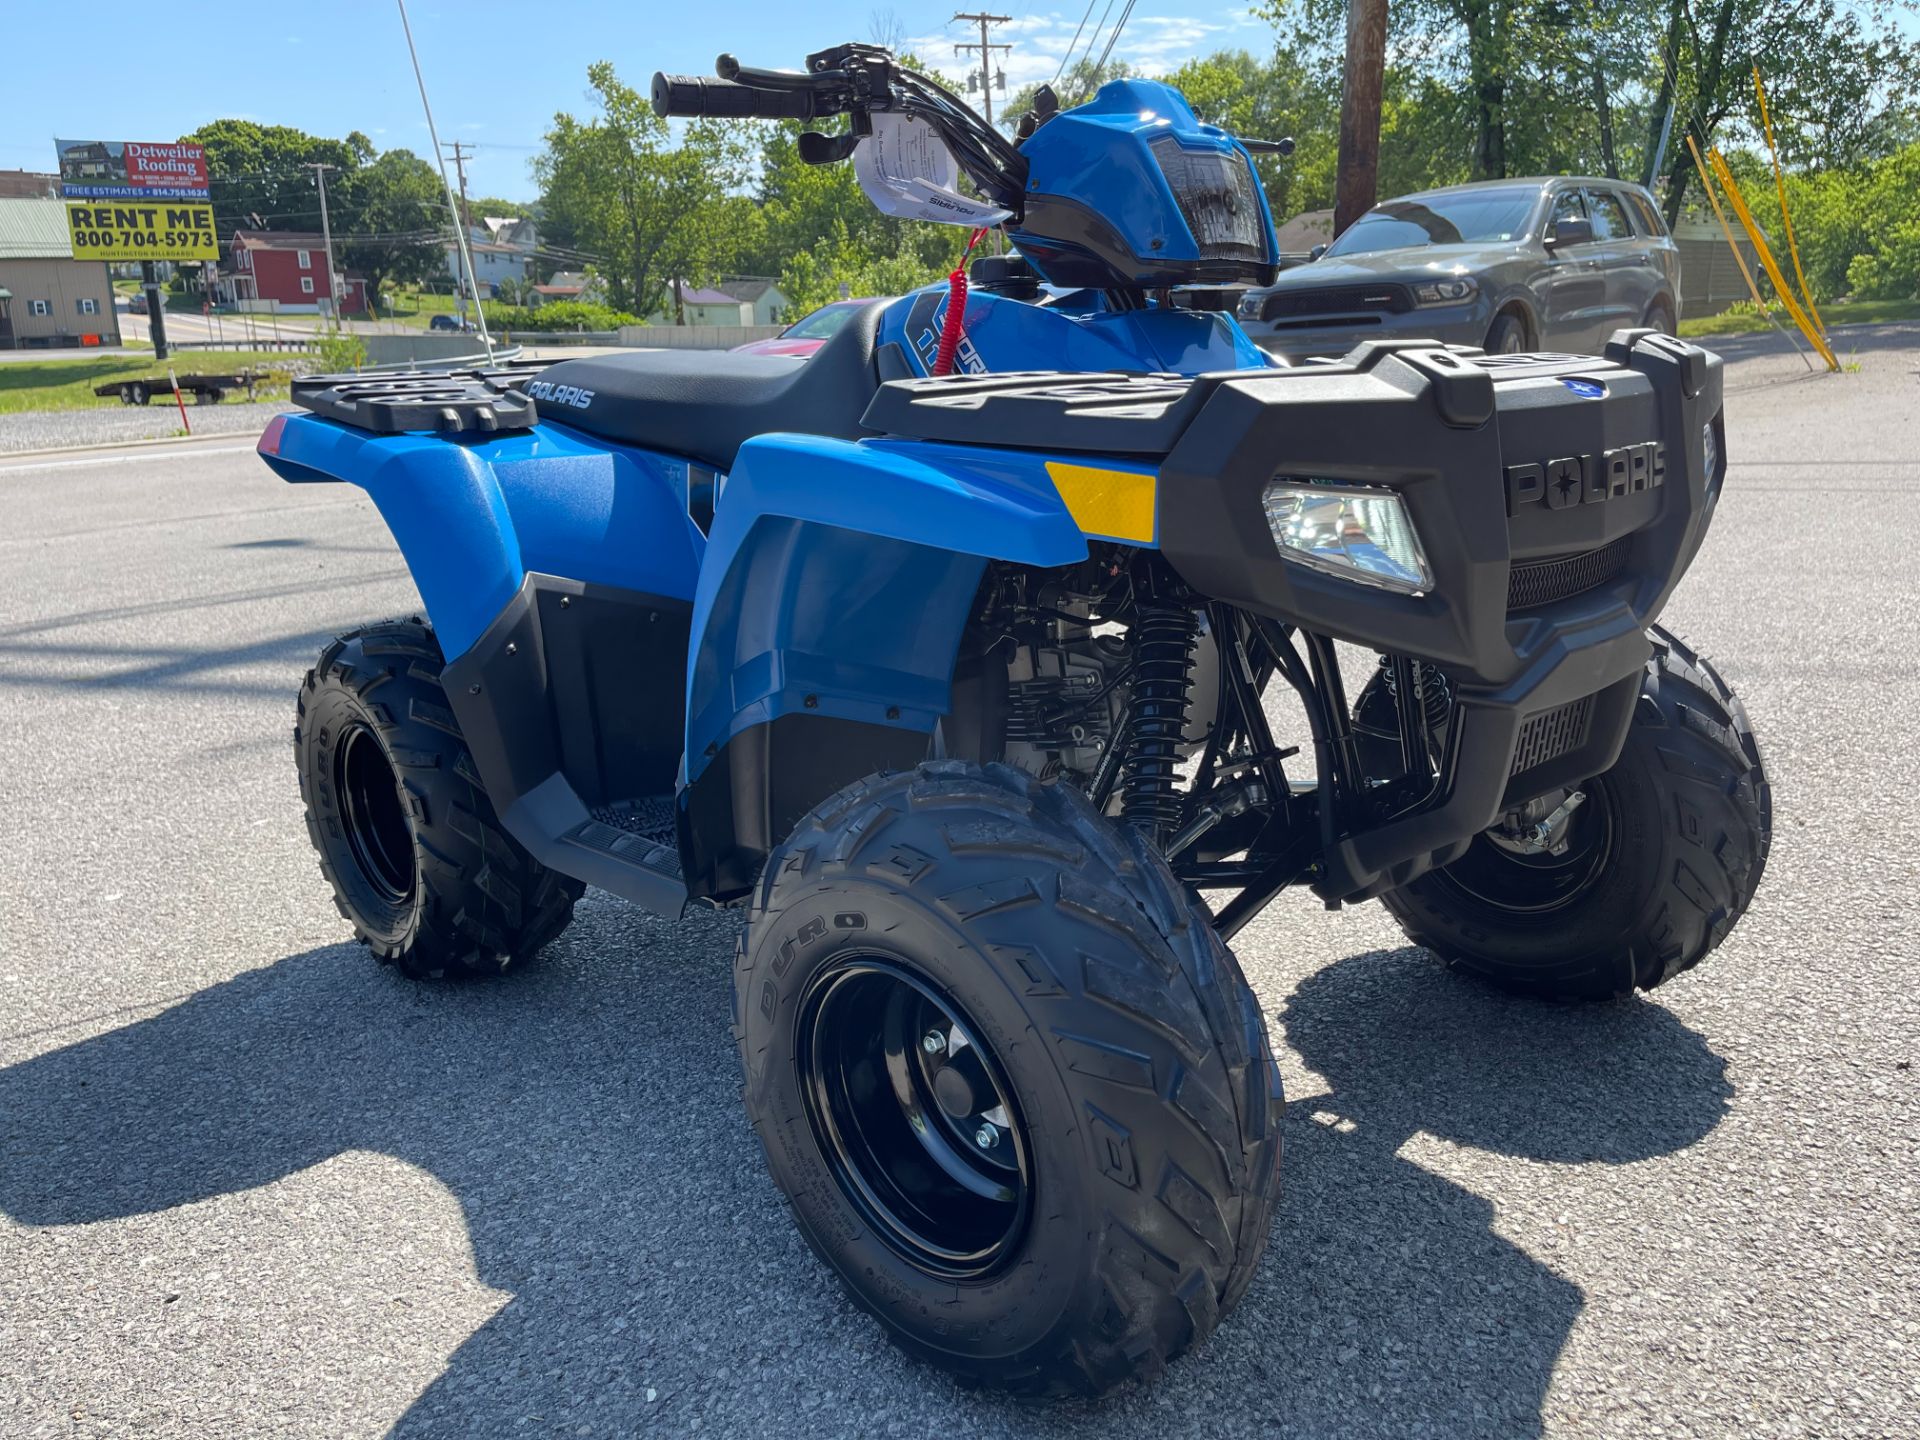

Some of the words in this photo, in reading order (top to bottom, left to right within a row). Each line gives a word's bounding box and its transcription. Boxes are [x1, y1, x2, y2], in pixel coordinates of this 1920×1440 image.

[127, 144, 202, 160] Detweiler
[136, 158, 197, 175] Roofing
[65, 187, 91, 196] FREE
[92, 187, 144, 197] ESTIMATES
[928, 196, 976, 216] POLARIS
[70, 208, 158, 229] RENT
[166, 209, 212, 230] ME
[75, 231, 214, 248] 800-704-5973
[100, 250, 149, 258] HUNTINGTON
[528, 381, 596, 409] POLARIS
[1504, 441, 1667, 517] POLARIS
[317, 725, 342, 841] DURO
[759, 910, 868, 1026] DURO
